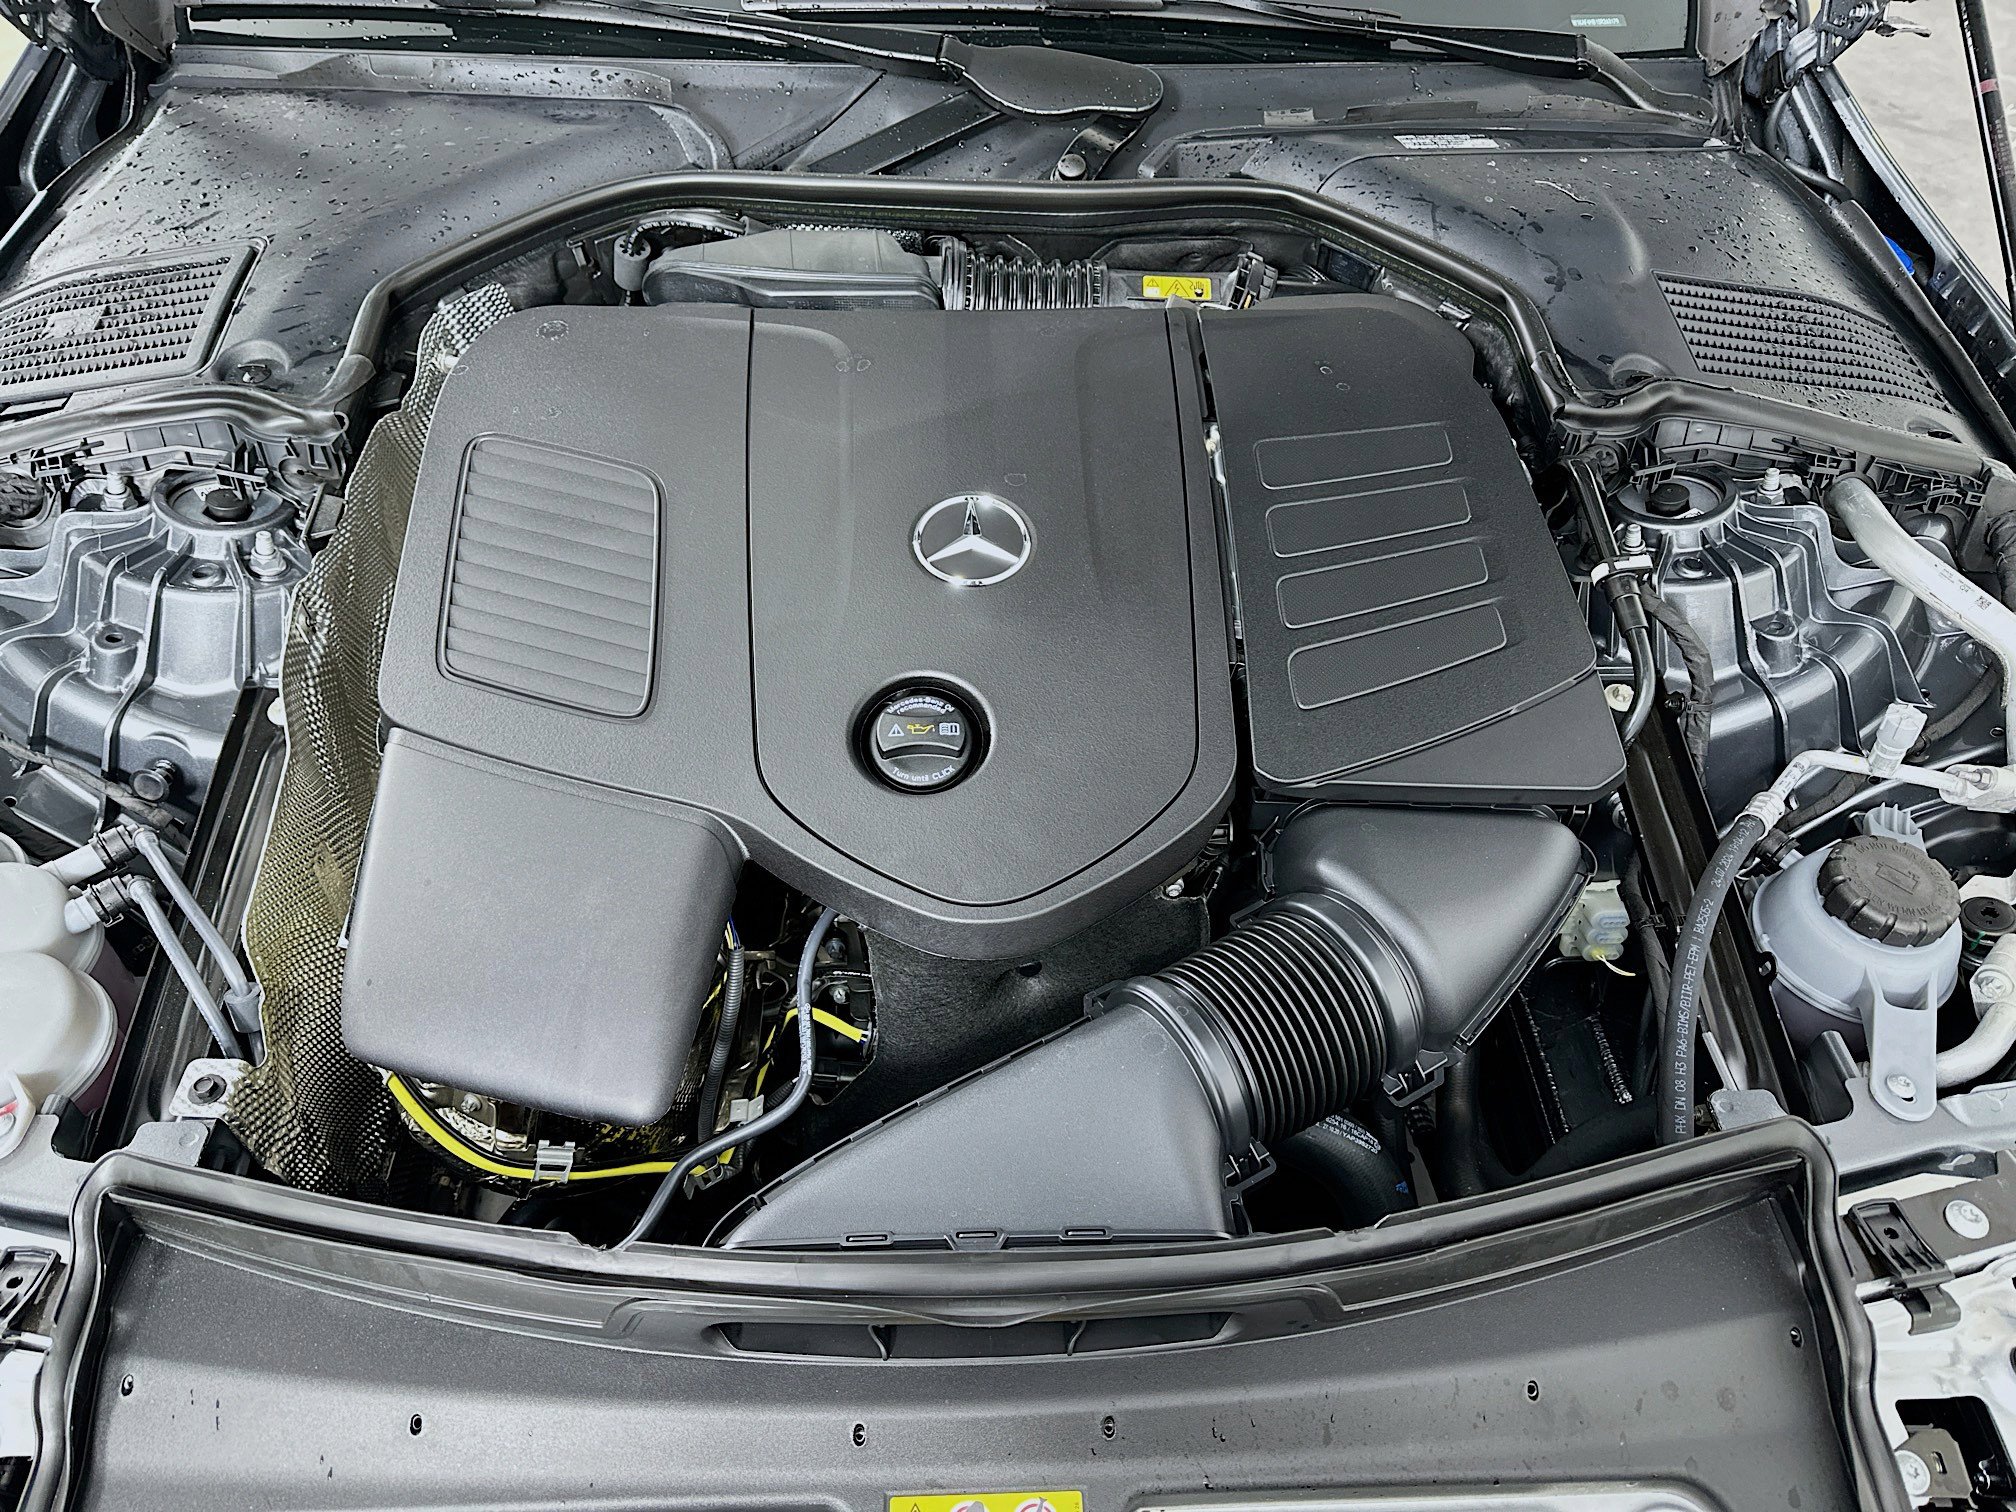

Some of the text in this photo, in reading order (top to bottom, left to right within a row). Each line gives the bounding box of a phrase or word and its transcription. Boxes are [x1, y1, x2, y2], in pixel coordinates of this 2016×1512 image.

[887, 697, 944, 713] Mercedes-Benz
[897, 702, 946, 715] recommended
[892, 764, 956, 782] Turn until CLICK
[1674, 1061, 1688, 1075] H3
[1674, 1079, 1687, 1093] 08
[1674, 1096, 1687, 1111] DN
[1674, 1114, 1687, 1134] PHX
